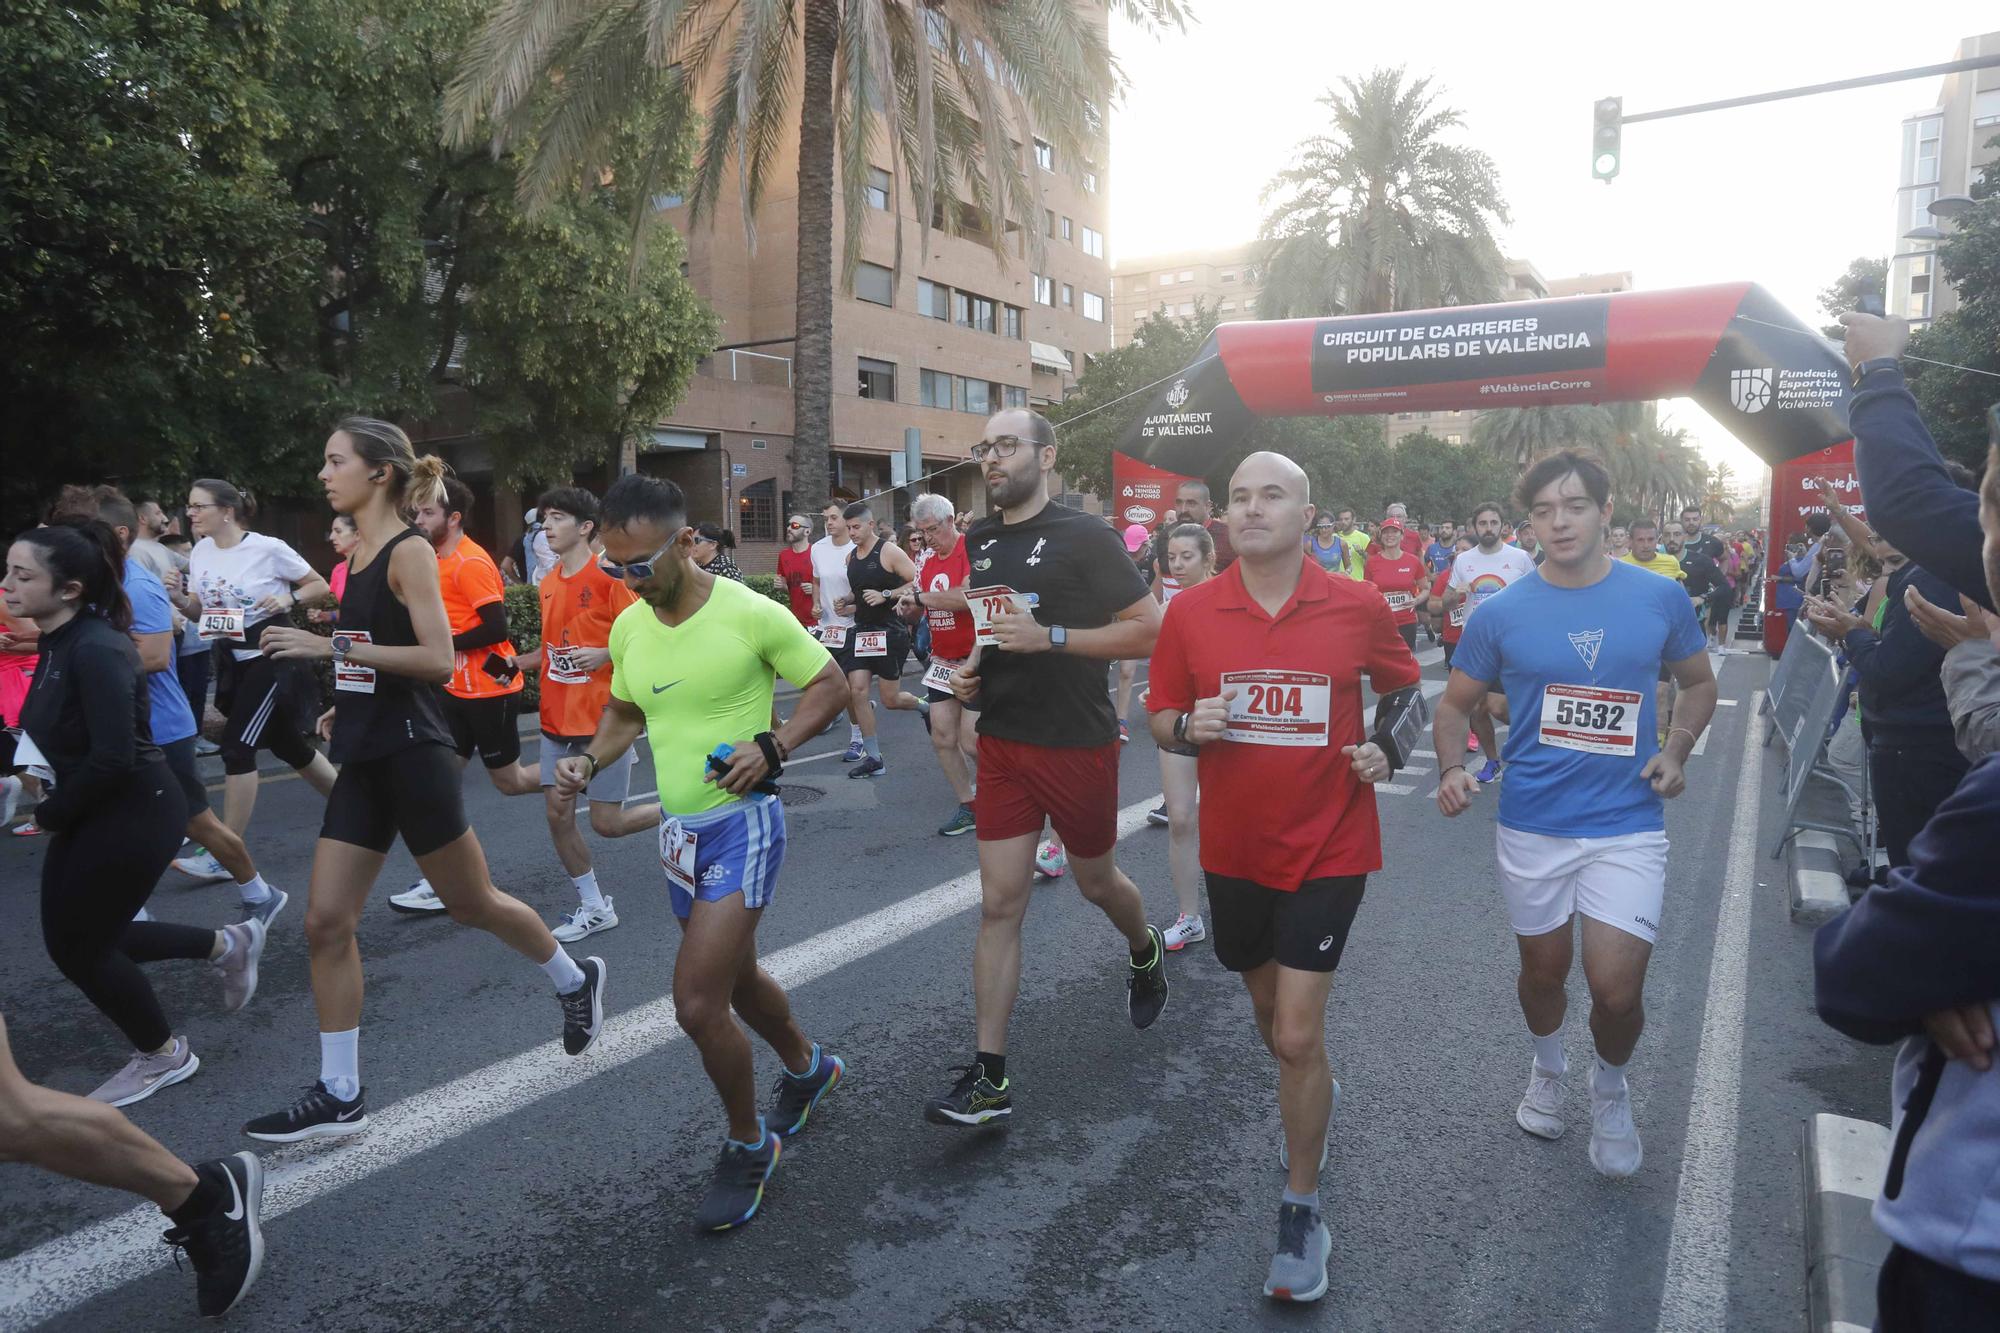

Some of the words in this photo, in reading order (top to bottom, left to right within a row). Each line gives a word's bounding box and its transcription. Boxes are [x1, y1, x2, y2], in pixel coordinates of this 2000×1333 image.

[1323, 329, 1397, 346] CIRCUIT
[1400, 326, 1424, 342] DE
[1429, 318, 1538, 339] CARRERES
[1347, 343, 1450, 363] POPULARS
[1454, 341, 1480, 357] DE
[1485, 332, 1591, 355] VALÈNCIA
[1780, 369, 1838, 379] Fundació
[1480, 379, 1591, 395] #ValènciaCorre
[1778, 380, 1841, 390] Esportiva
[1777, 389, 1843, 400] Municipal
[1777, 400, 1833, 410] València
[1144, 412, 1212, 426] AJUNTAMENT
[1142, 427, 1154, 437] DE
[1158, 423, 1213, 436] VALÈNCIA
[1127, 510, 1152, 519] Serrano
[205, 616, 235, 630] 4570
[861, 636, 878, 648] 240
[932, 666, 955, 681] 585
[1247, 685, 1303, 717] 204
[1556, 699, 1625, 731] 5532
[1251, 724, 1298, 732] #ValènciaCorre
